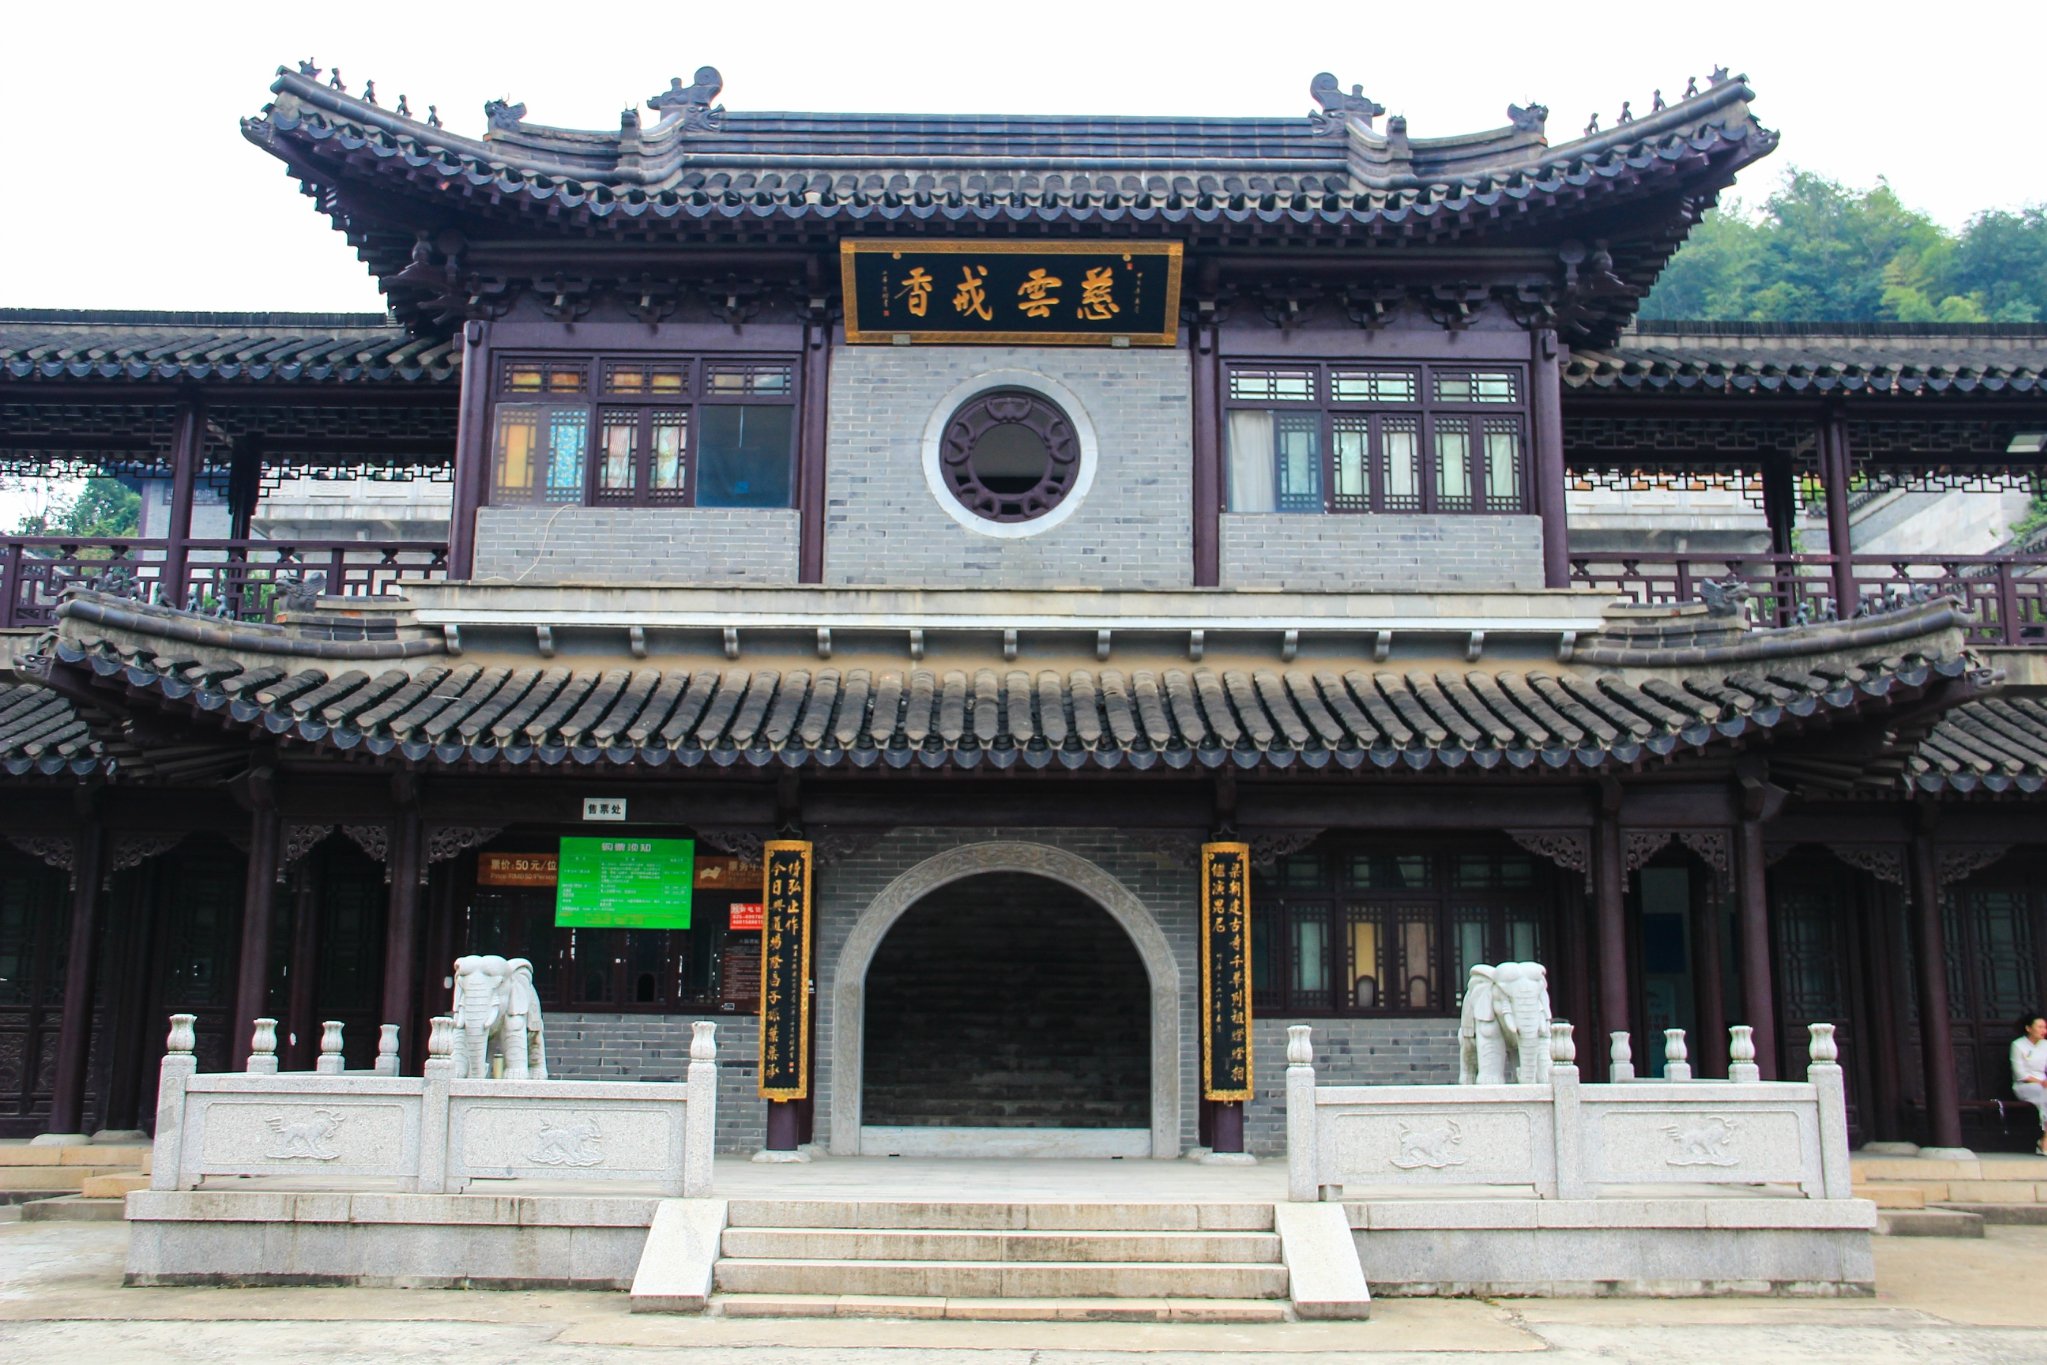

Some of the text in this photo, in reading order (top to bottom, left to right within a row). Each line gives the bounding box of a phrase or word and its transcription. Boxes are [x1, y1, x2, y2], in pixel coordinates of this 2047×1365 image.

[588, 803, 622, 815] 售票处
[601, 842, 652, 853] 购票须知
